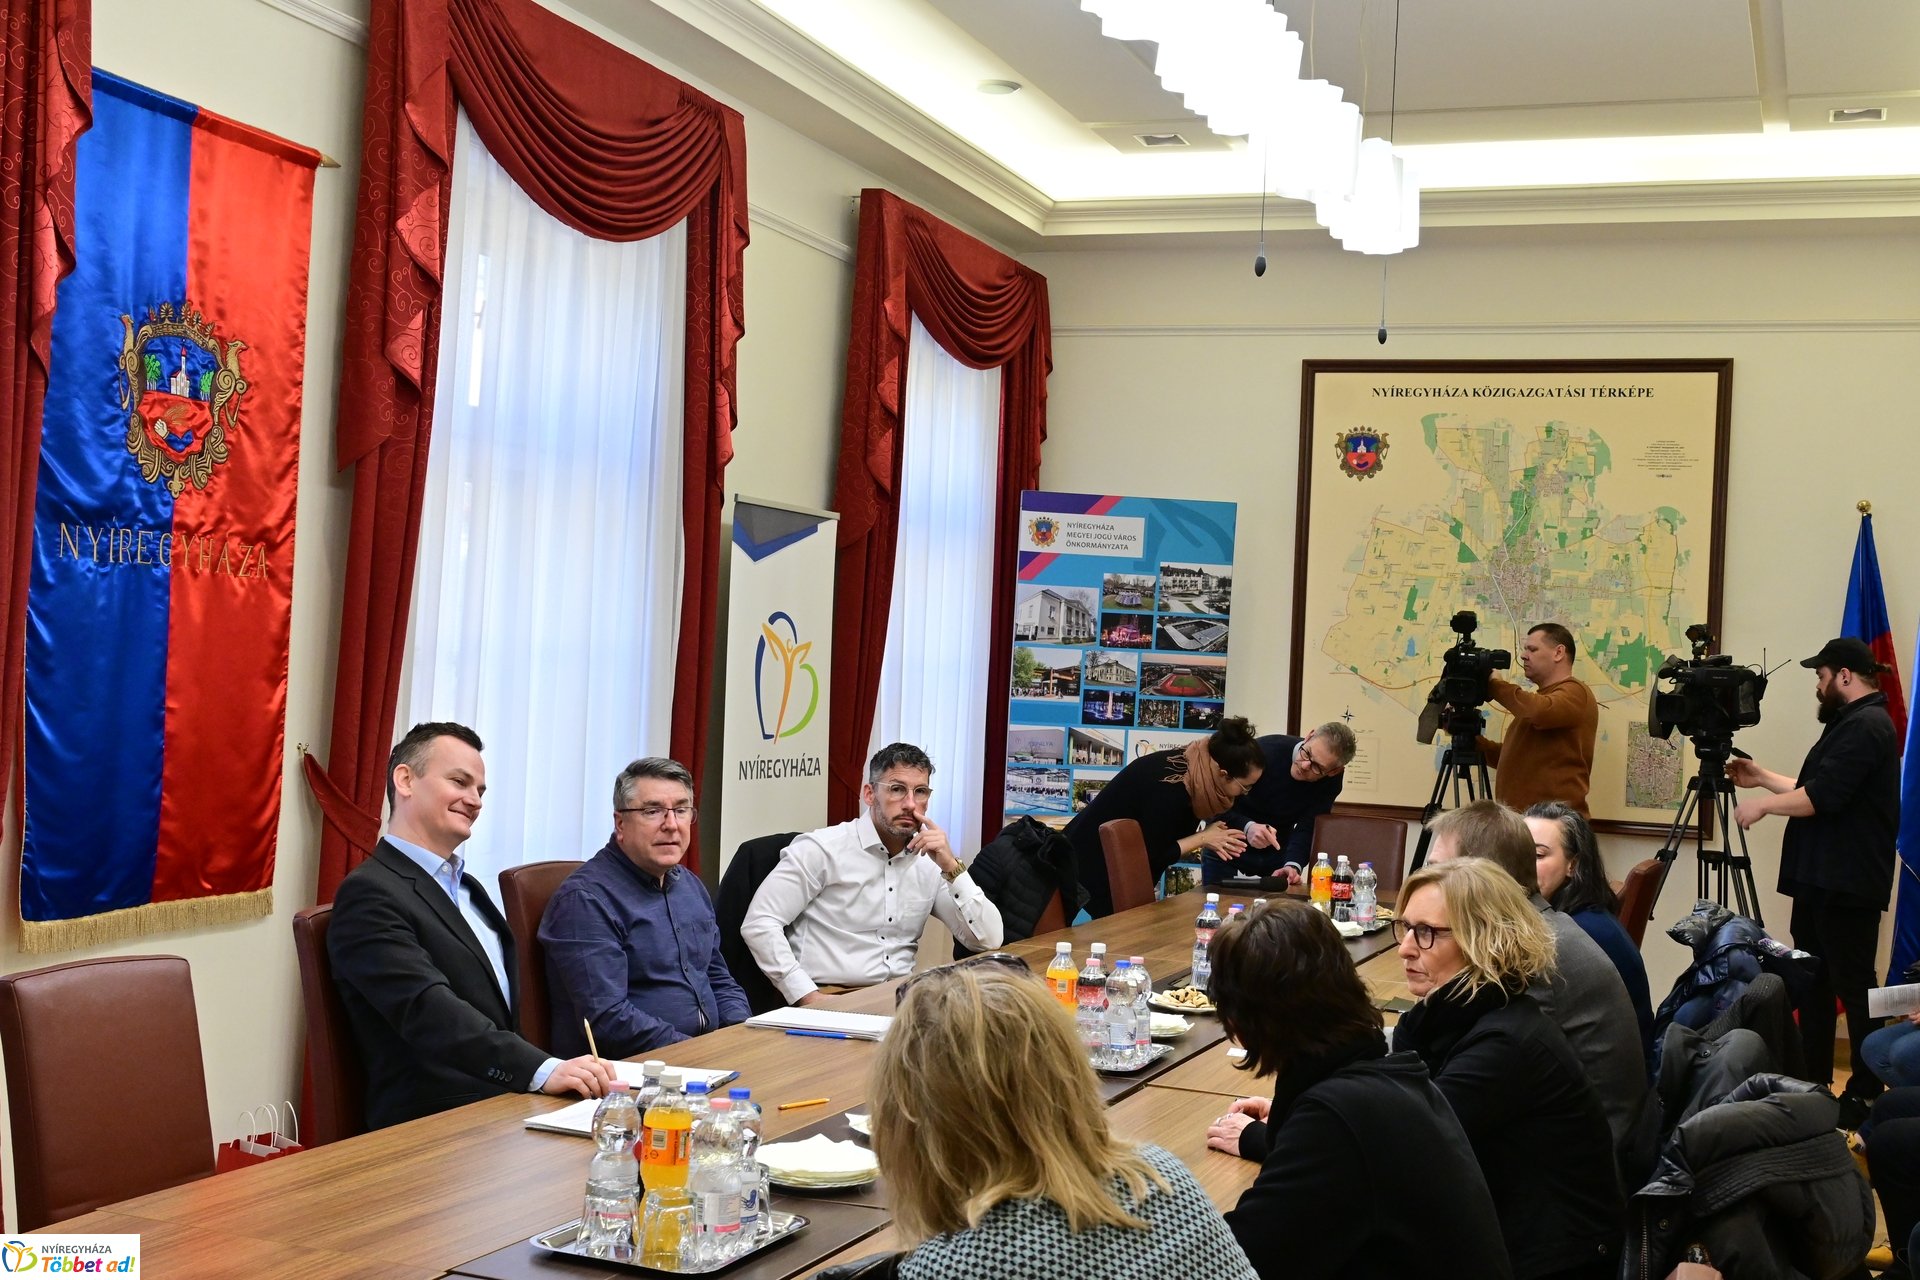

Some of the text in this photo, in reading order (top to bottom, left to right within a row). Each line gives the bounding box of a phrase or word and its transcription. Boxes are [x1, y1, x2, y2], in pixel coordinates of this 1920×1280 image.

[1372, 384, 1655, 398] NYÍREGYHÁZA KÖZIGAZGATÁSI TÉRKÉPE
[1066, 521, 1115, 531] NYÍREGYHÁZA
[1066, 531, 1093, 540] MEGYEI
[1113, 533, 1137, 542] VÁROS
[1065, 539, 1129, 551] ÖNKORMÁNYZATA
[738, 752, 821, 781] NYÍREGYHÁZA
